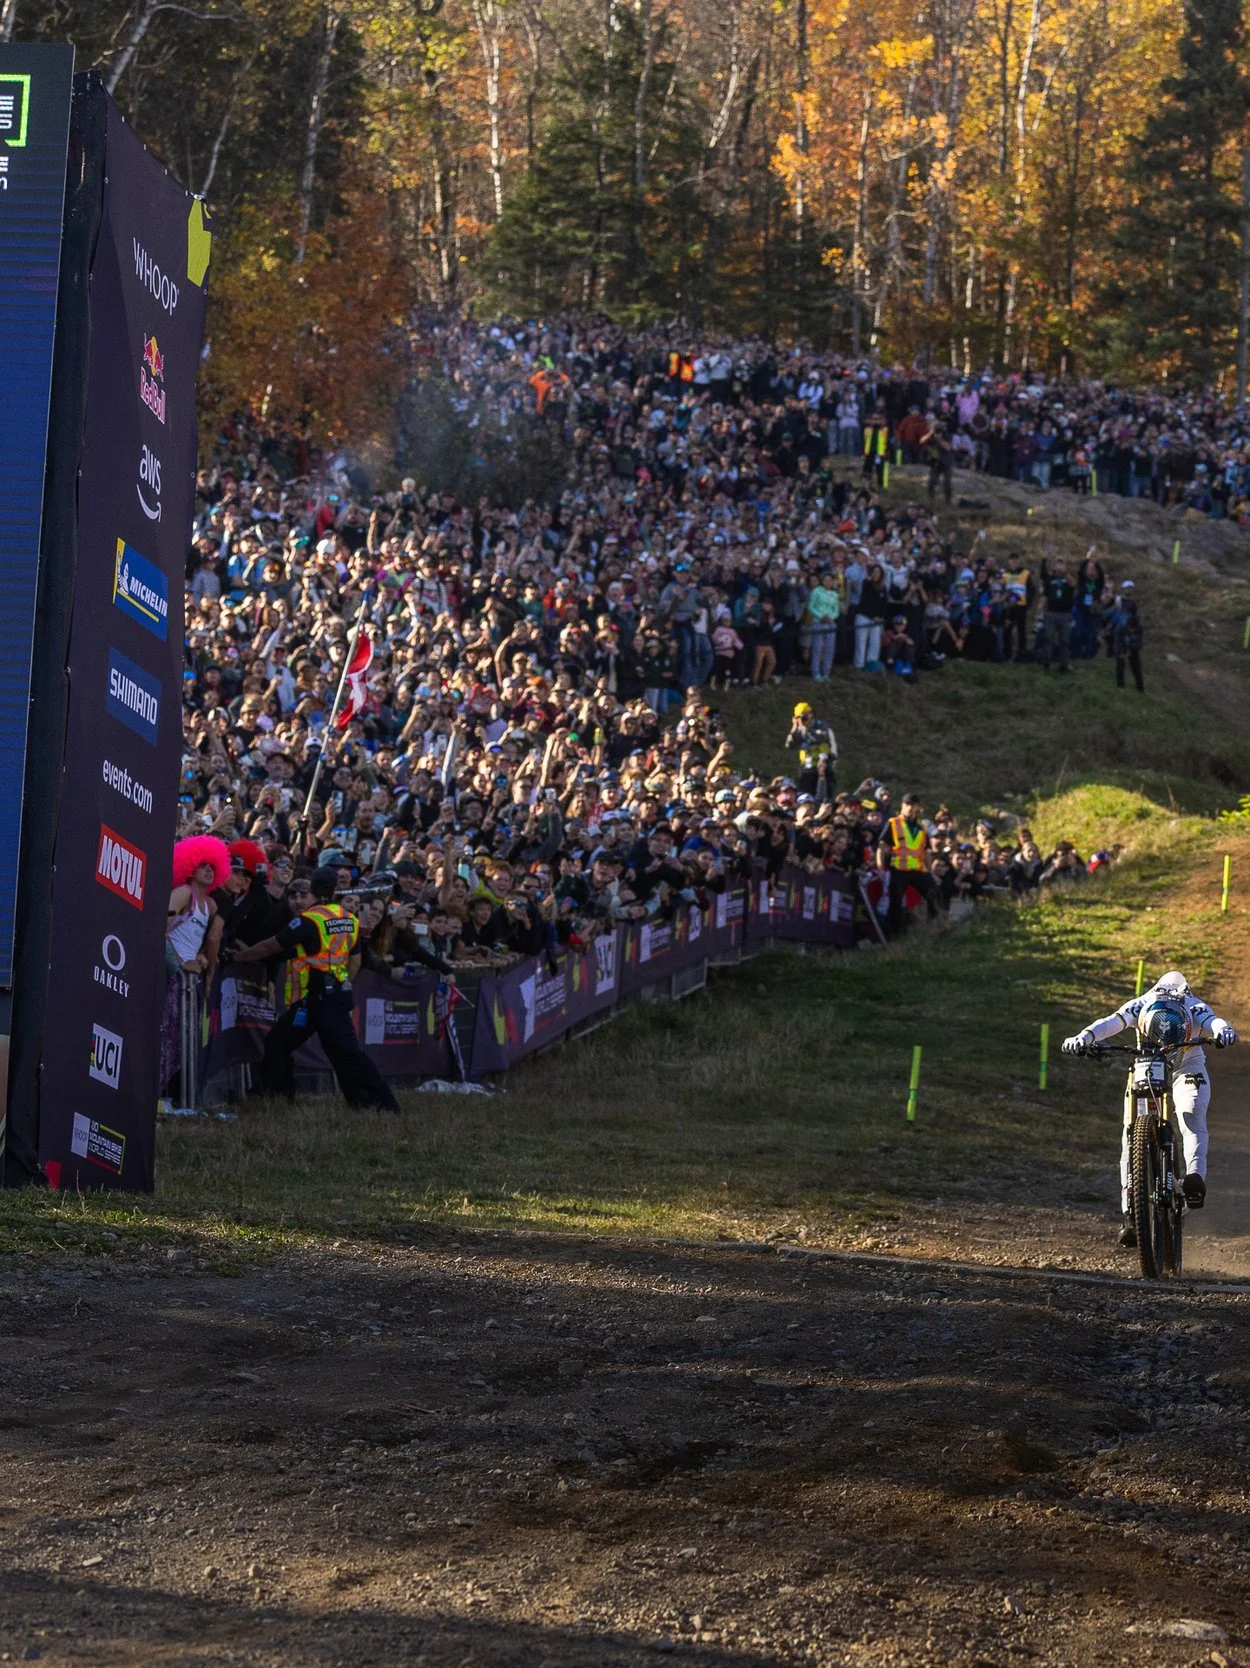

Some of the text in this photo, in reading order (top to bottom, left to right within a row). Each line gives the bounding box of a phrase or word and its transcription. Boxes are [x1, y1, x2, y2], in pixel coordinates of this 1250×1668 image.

[139, 443, 161, 496] aws
[130, 577, 168, 617] MICHELIN
[109, 668, 158, 725] SHIMANO
[103, 759, 153, 814] events.com
[99, 835, 143, 900] MOTUL
[94, 966, 130, 998] OAKLEY
[96, 1035, 119, 1079] UCI
